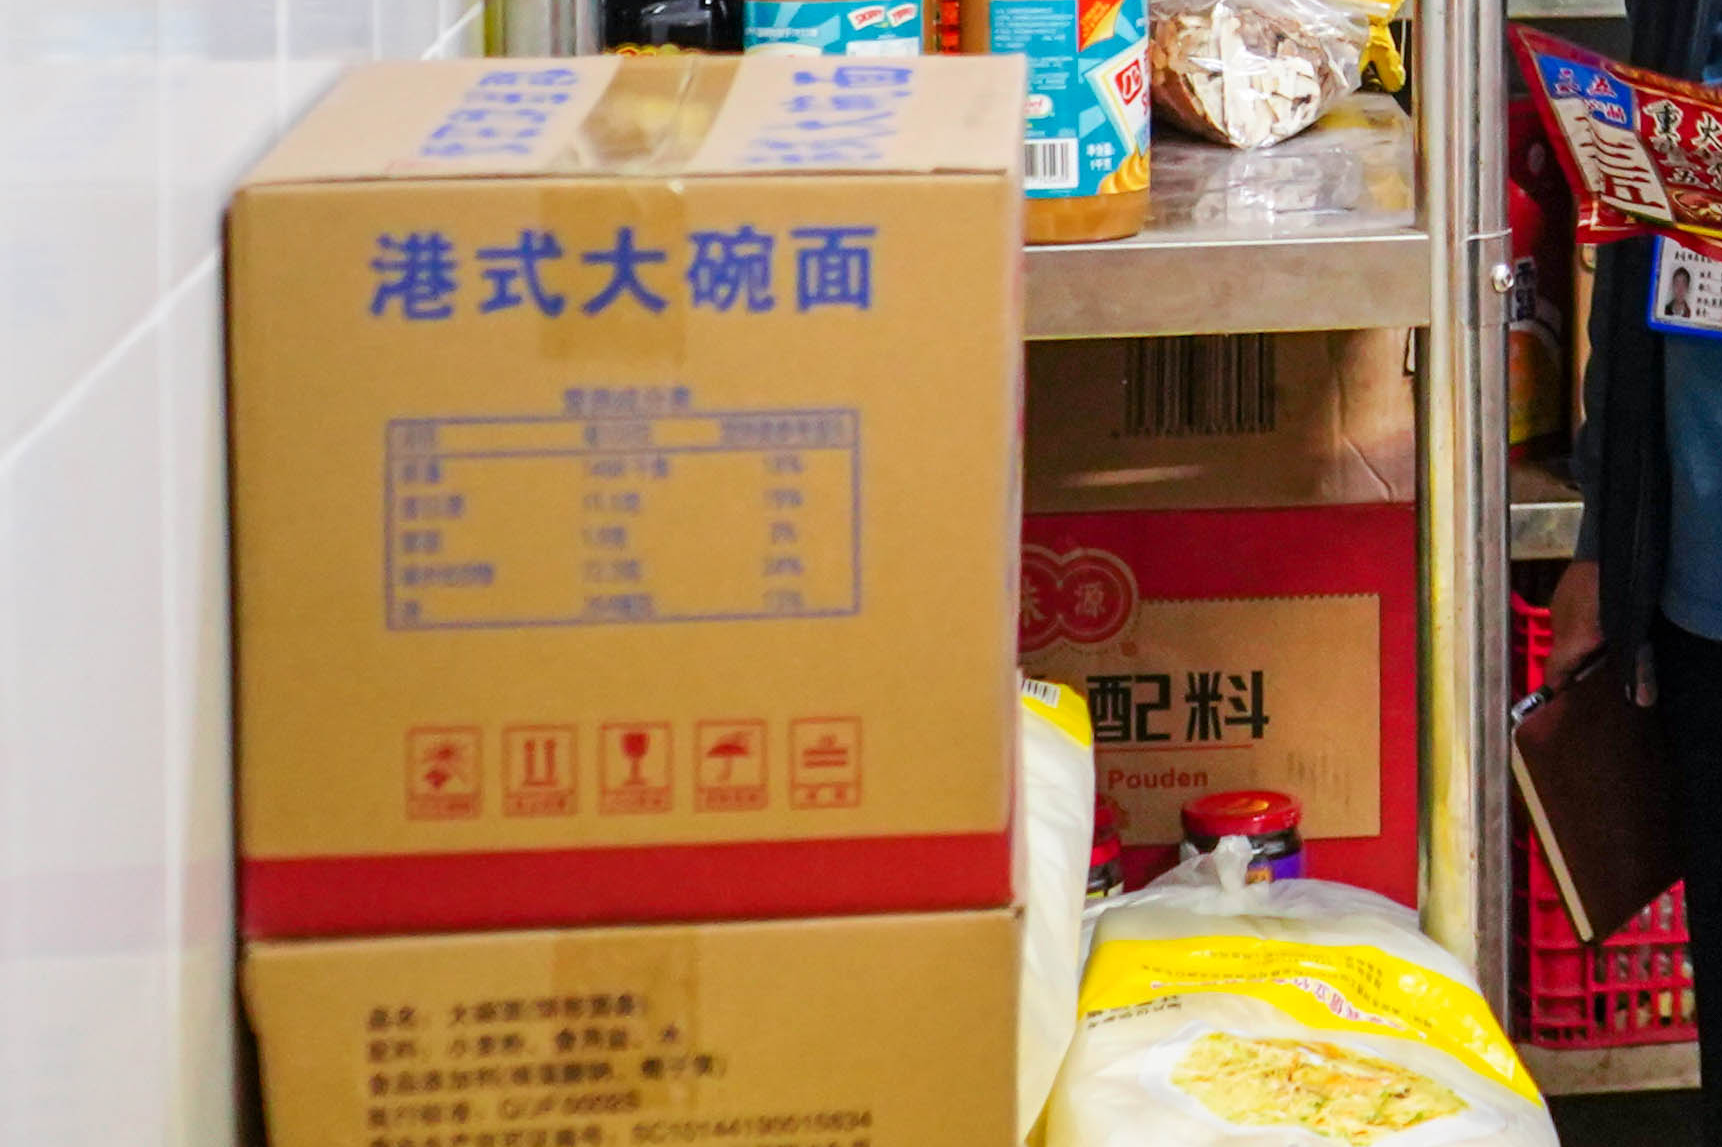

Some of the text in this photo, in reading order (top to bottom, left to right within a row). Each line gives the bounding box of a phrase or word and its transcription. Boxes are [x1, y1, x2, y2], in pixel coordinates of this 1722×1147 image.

[369, 226, 877, 320] 港式大碗面
[1086, 671, 1269, 743] 配料
[1107, 767, 1209, 790] Pouden
